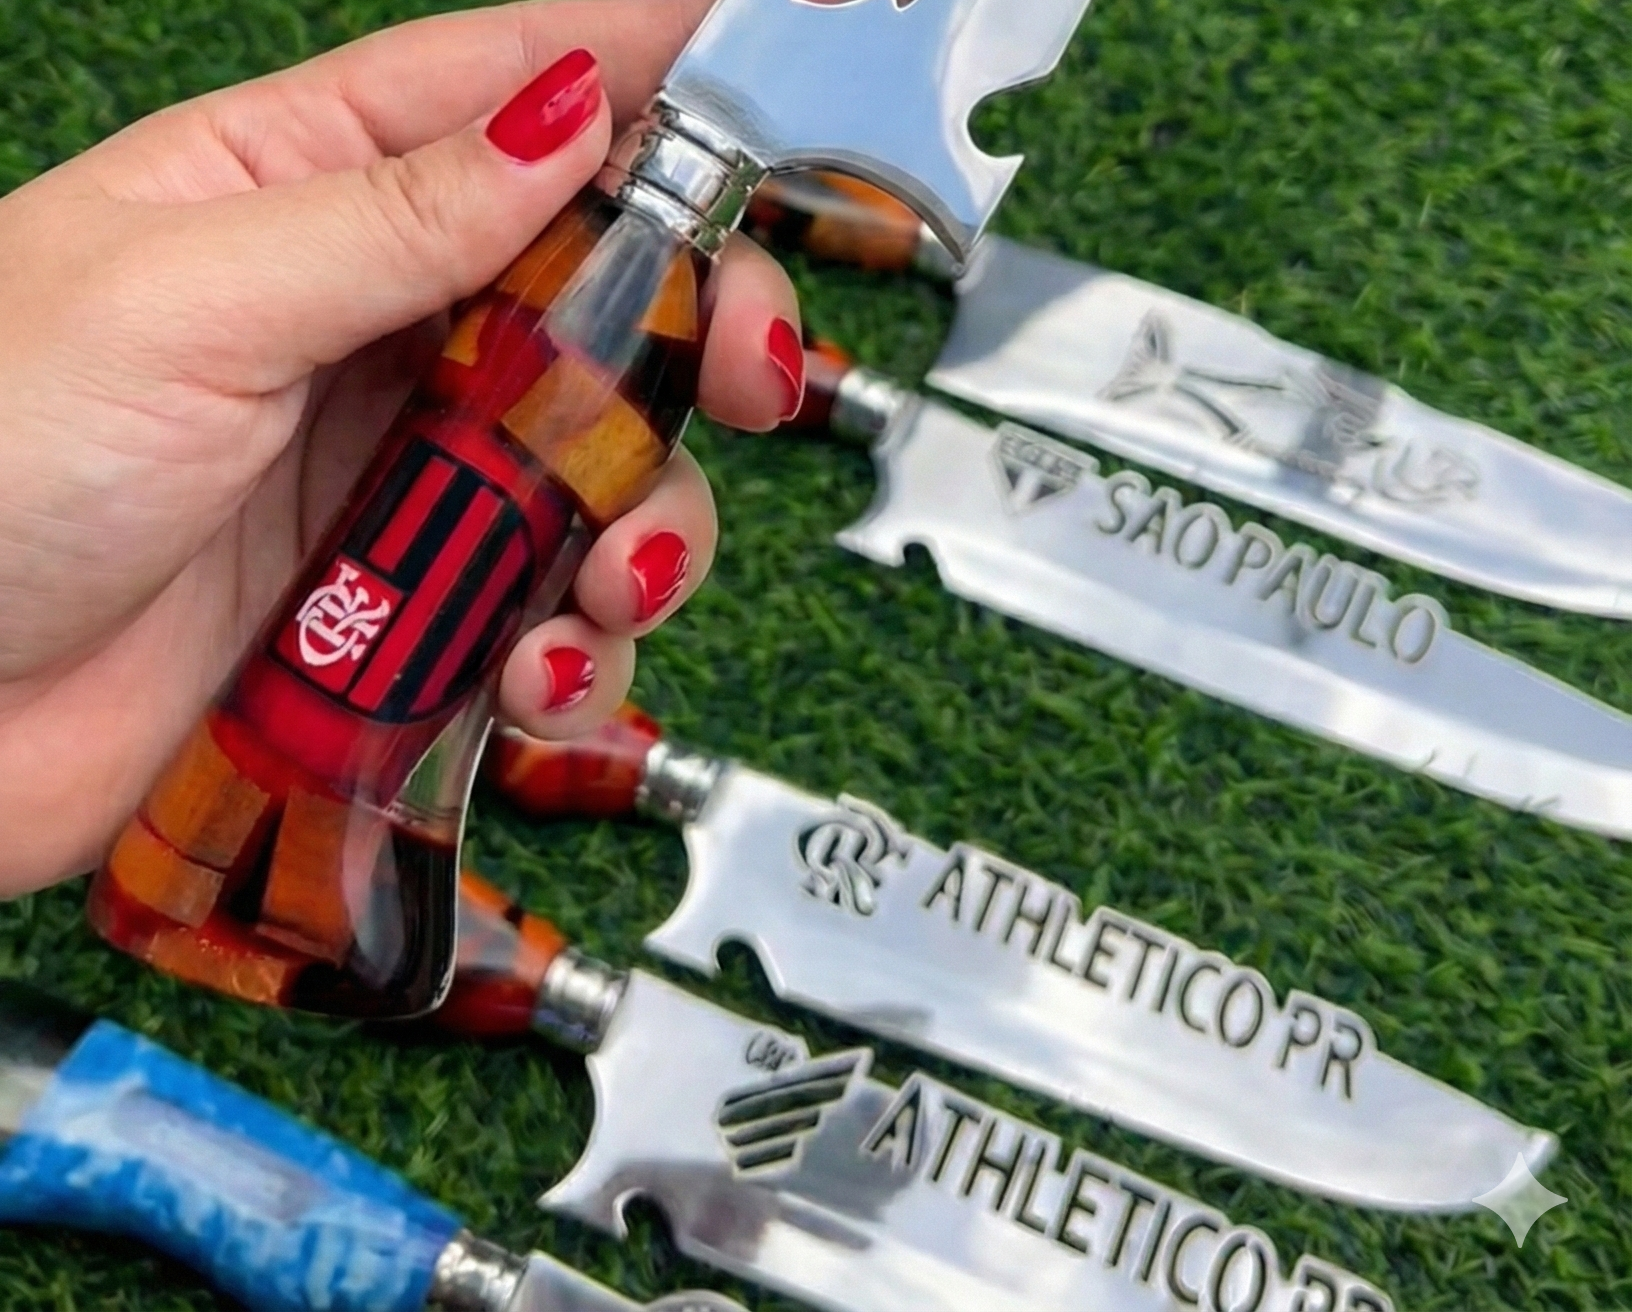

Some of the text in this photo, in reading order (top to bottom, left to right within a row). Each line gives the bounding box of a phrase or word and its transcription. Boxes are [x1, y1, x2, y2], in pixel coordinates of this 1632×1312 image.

[1093, 479, 1438, 666] SAO PAULO
[922, 852, 1266, 1049] ATHLETICO
[1277, 1004, 1365, 1100] PR
[864, 1080, 1268, 1312] ATHLETICO
